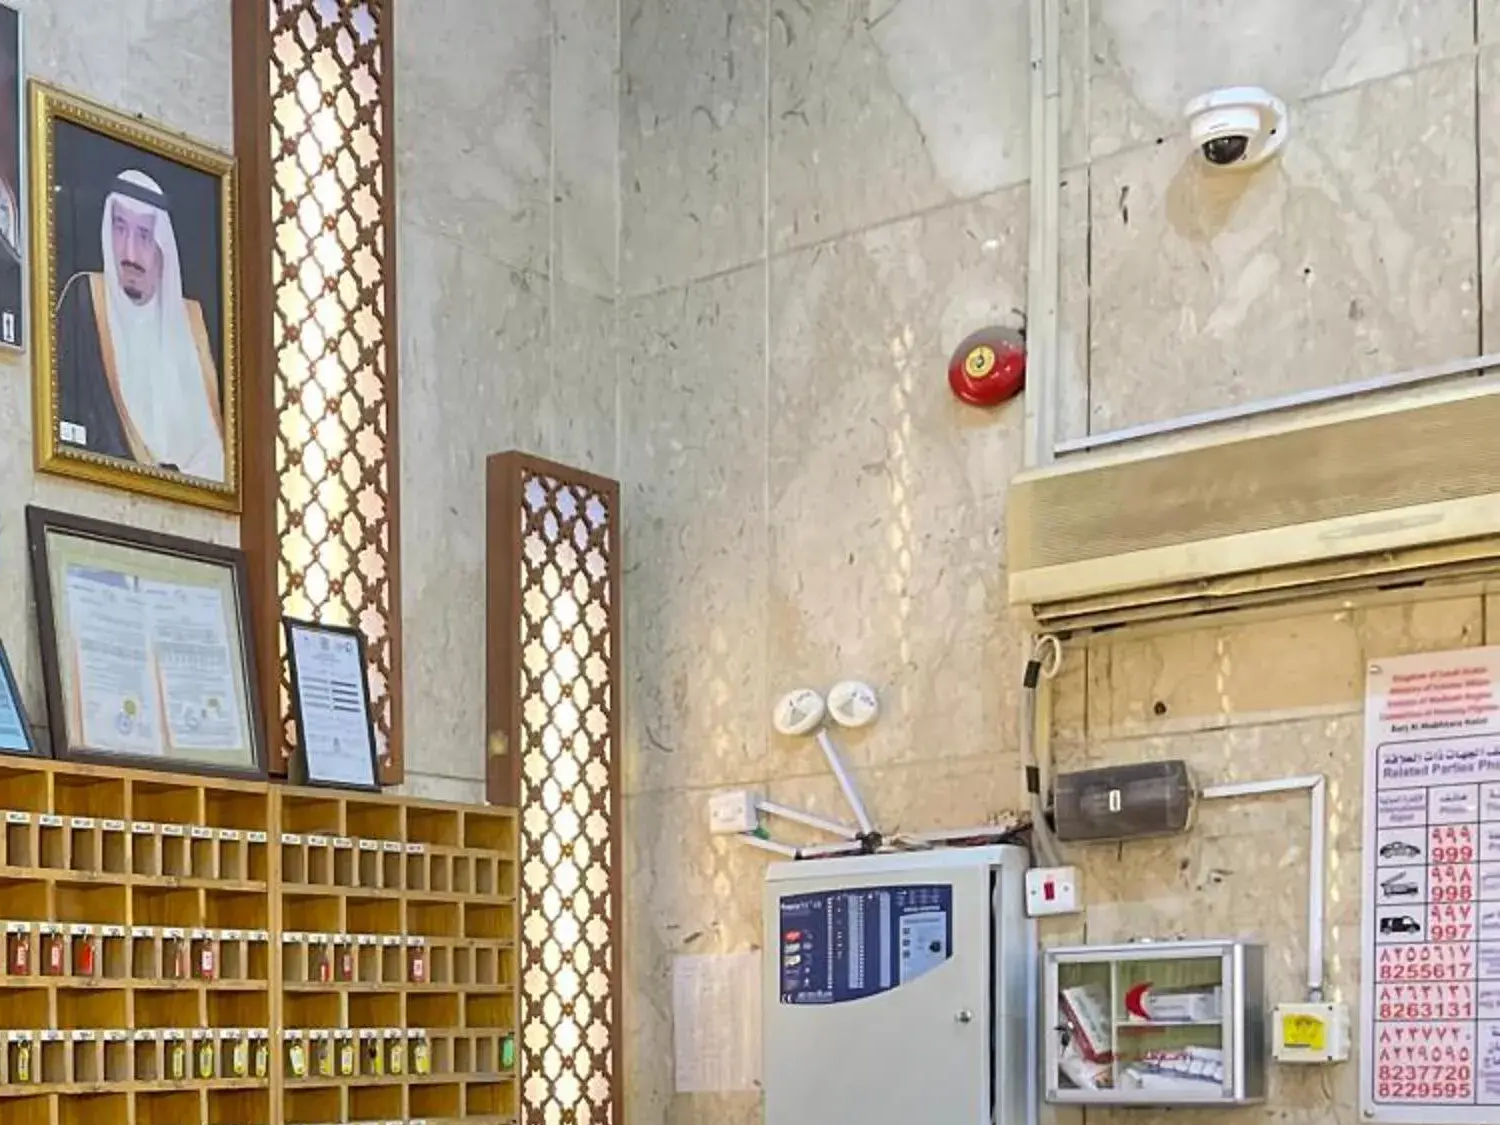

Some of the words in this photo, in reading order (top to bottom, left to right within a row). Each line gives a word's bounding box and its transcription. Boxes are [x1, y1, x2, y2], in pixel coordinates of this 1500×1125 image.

[1383, 765, 1429, 778] Related
[1432, 846, 1473, 862] 999
[1431, 885, 1472, 901] 998
[1431, 924, 1472, 941] 997
[1380, 963, 1471, 979] 8255617
[1380, 1002, 1471, 1018] 8263131
[1379, 1066, 1470, 1081] 8237720
[1379, 1082, 1471, 1098] 8229595
